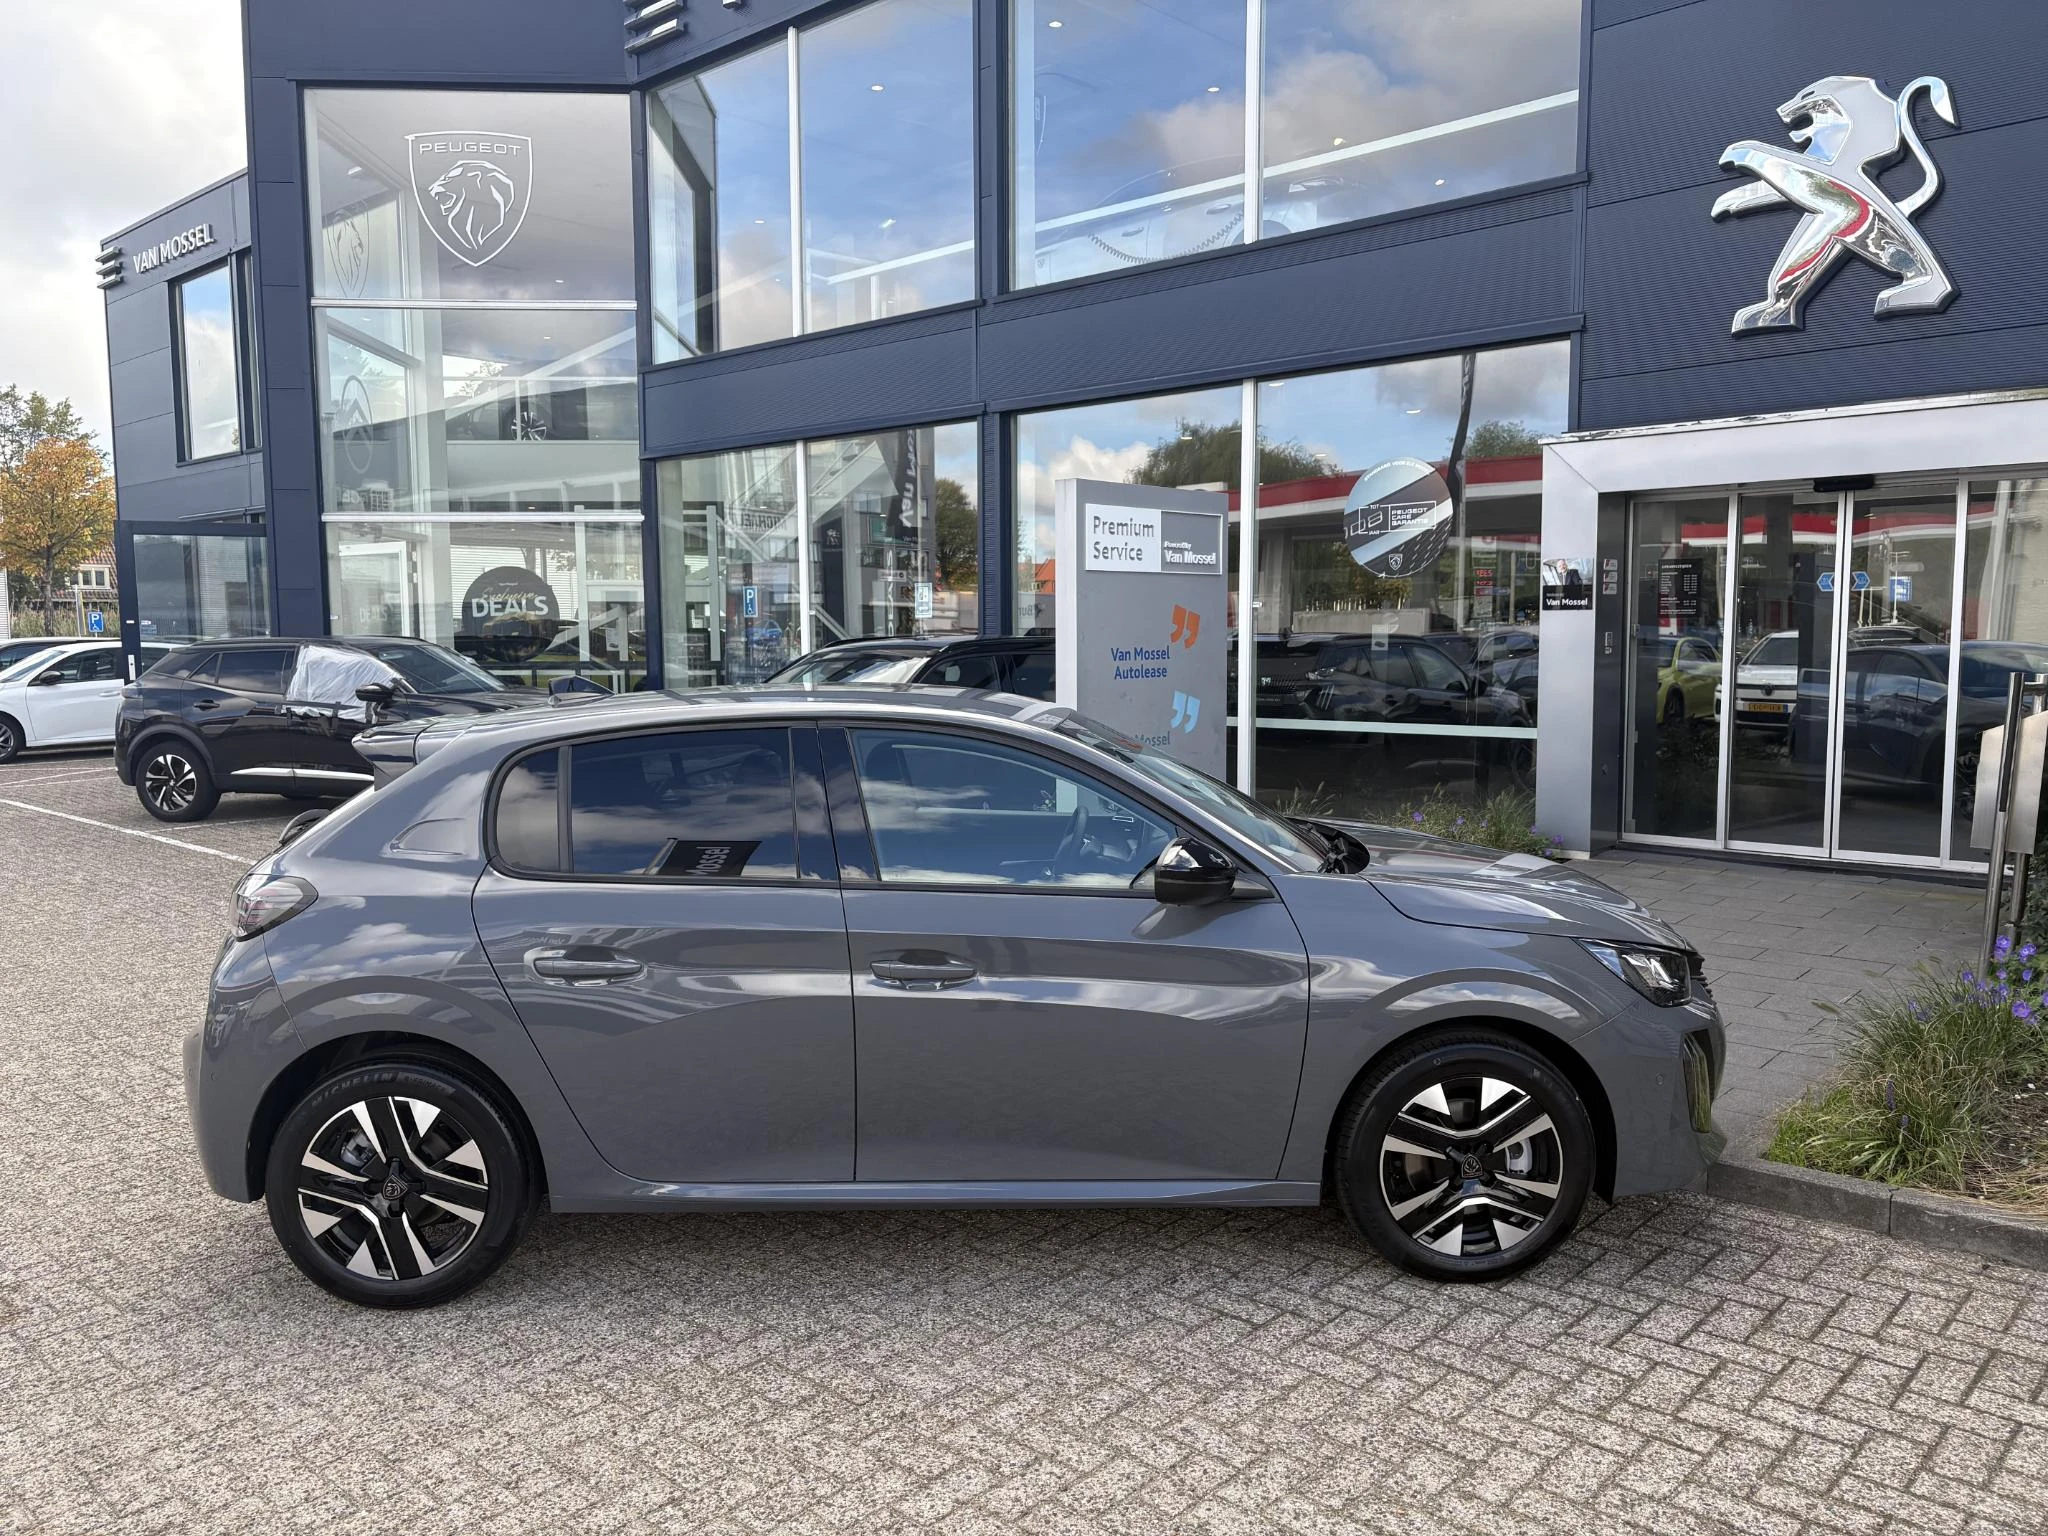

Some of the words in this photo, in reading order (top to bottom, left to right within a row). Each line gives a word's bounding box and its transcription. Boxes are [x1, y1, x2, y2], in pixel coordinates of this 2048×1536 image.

[419, 142, 521, 155] PEUGEOT
[132, 246, 160, 273] VAN
[159, 223, 215, 263] MOSSEL
[1391, 507, 1428, 515] PEUGEOT
[1093, 515, 1155, 538] Premium
[1093, 541, 1143, 562] Service
[1165, 550, 1183, 563] Van
[1184, 552, 1217, 565] Mossel
[747, 589, 754, 603] P
[1545, 598, 1560, 606] Van
[1561, 597, 1588, 606] Mossel
[471, 595, 549, 618] DEALS
[91, 613, 100, 624] P
[1111, 648, 1131, 662] Van
[1134, 645, 1170, 661] Mossel
[1114, 664, 1168, 680] Autolease
